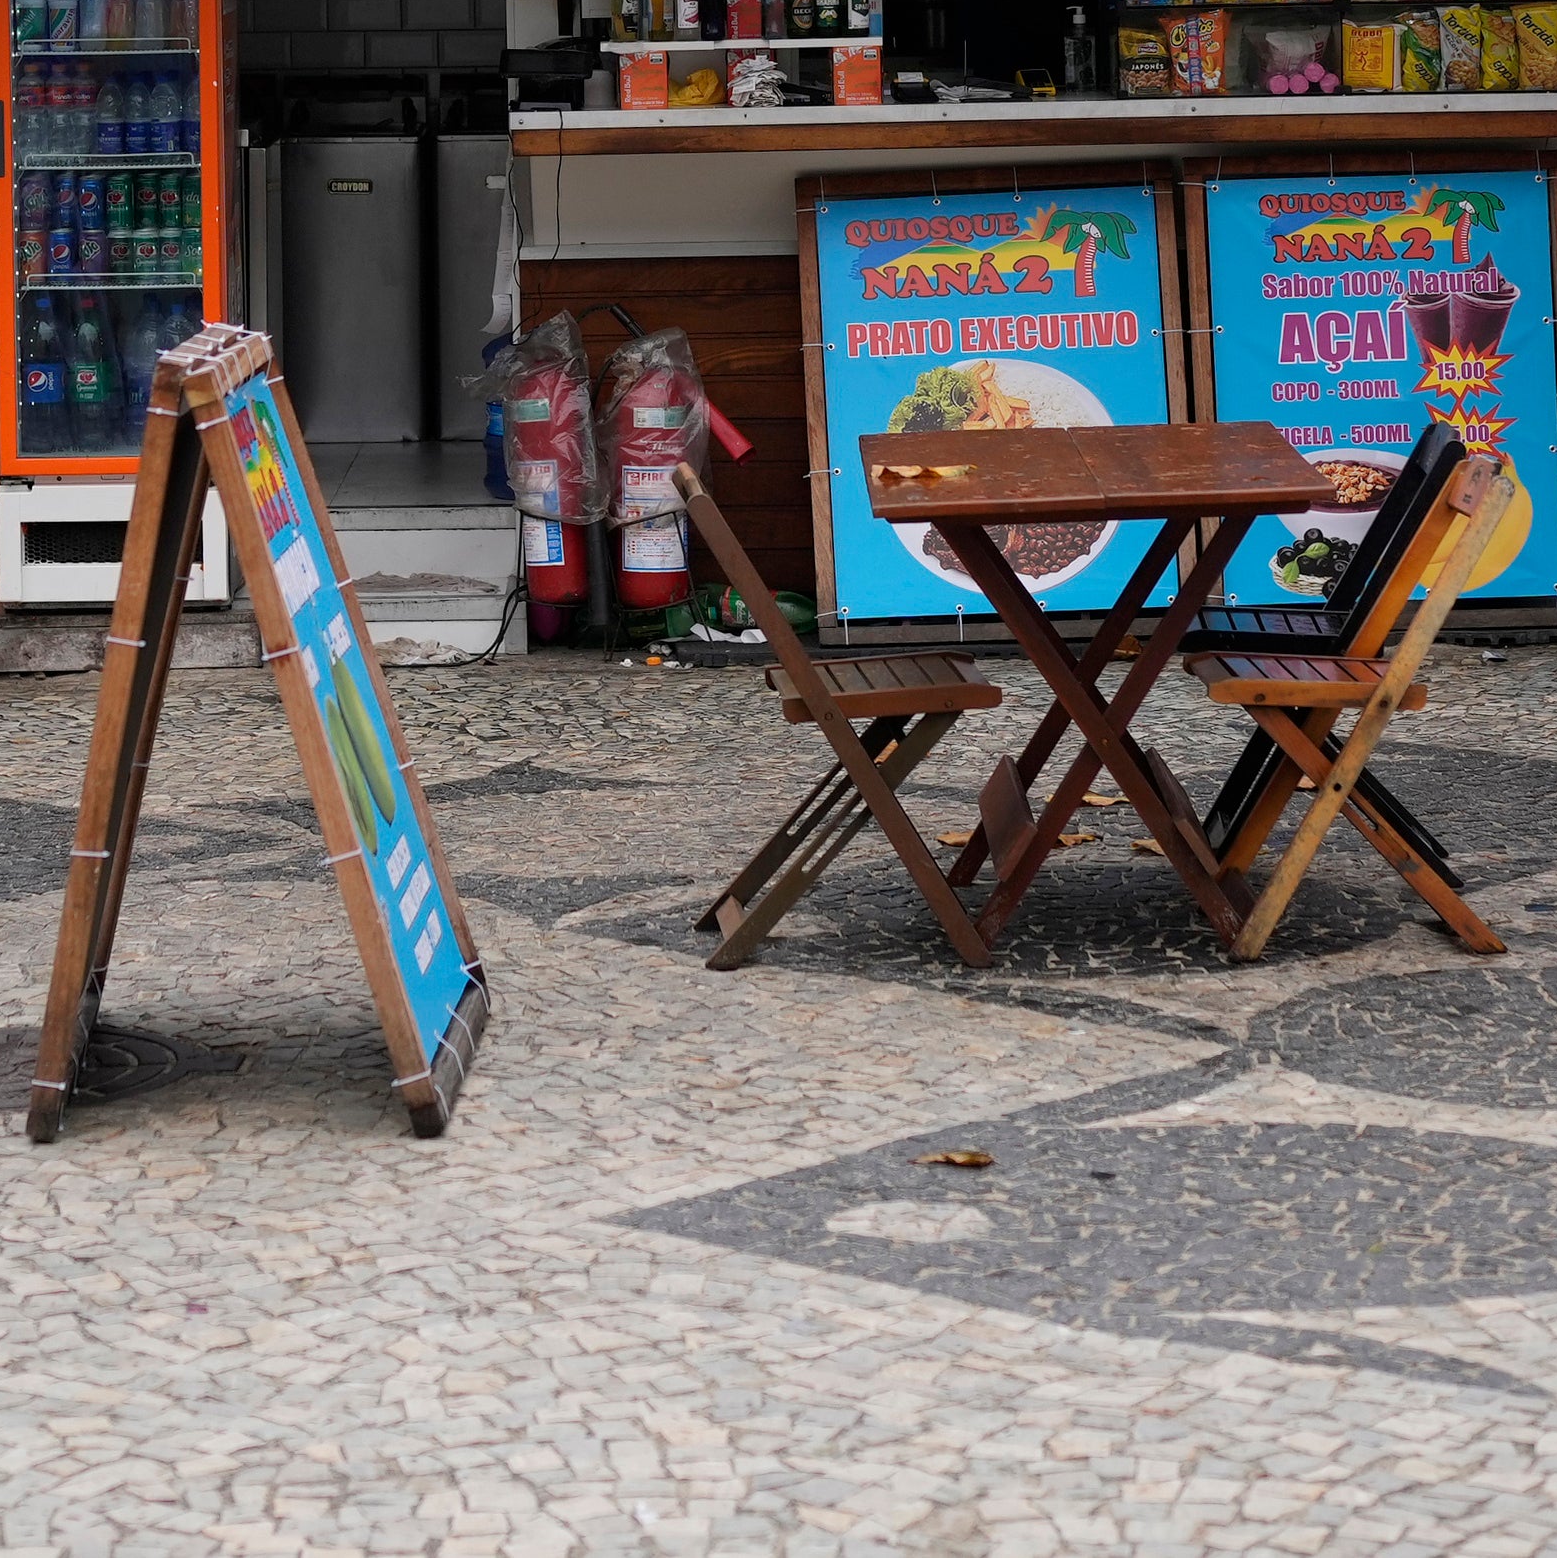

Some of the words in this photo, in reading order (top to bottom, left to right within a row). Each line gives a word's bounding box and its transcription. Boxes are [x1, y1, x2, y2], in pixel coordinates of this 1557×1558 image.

[1443, 13, 1480, 48] Torcida
[1519, 12, 1555, 48] Torcida
[838, 70, 846, 84] Bull
[1131, 60, 1165, 71] JAPONÊS
[624, 74, 632, 88] Bull
[838, 84, 846, 99] Red
[624, 88, 632, 103] Red
[330, 180, 370, 193] CROYDON
[1259, 191, 1406, 218] QUIOSQUE
[845, 212, 1019, 247] QUIOSQUE
[1272, 225, 1397, 262] NANÁ
[1401, 227, 1434, 260] 2
[861, 253, 1008, 300] NANÁ
[1013, 255, 1052, 294] 2
[1262, 274, 1333, 299] Sabor
[1339, 271, 1403, 297] 100%
[1409, 268, 1498, 295] Natural
[847, 319, 952, 358] PRATO
[959, 310, 1138, 353] EXECUTIVO
[1279, 301, 1409, 373] AÇAÍ
[1435, 362, 1486, 380] 15,00
[1272, 382, 1319, 401] COPO
[641, 472, 666, 481] FIRE
